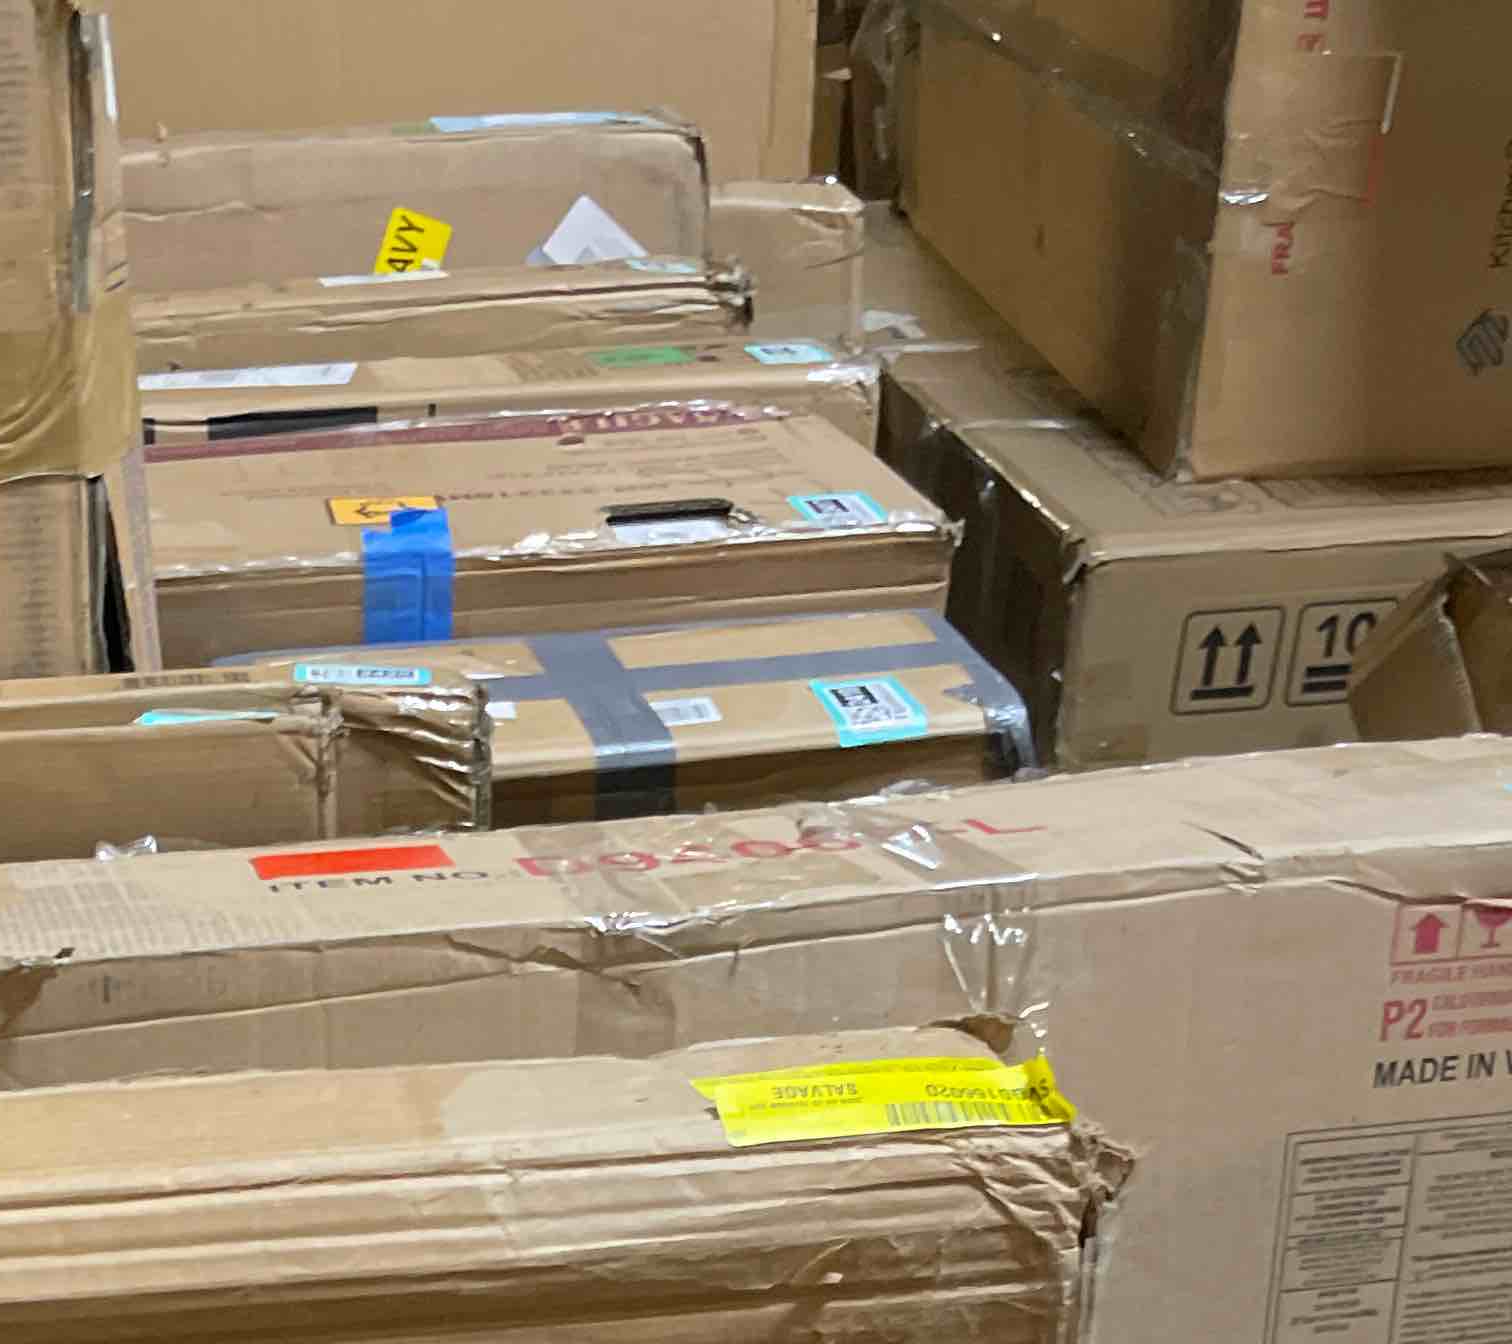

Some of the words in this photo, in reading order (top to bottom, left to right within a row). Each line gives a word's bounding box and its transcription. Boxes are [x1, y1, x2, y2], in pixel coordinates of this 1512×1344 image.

[1380, 998, 1428, 1042] P2
[1373, 1054, 1459, 1088] MADE
[1465, 1050, 1497, 1080] IN
[771, 1082, 858, 1101] SALVAGE
